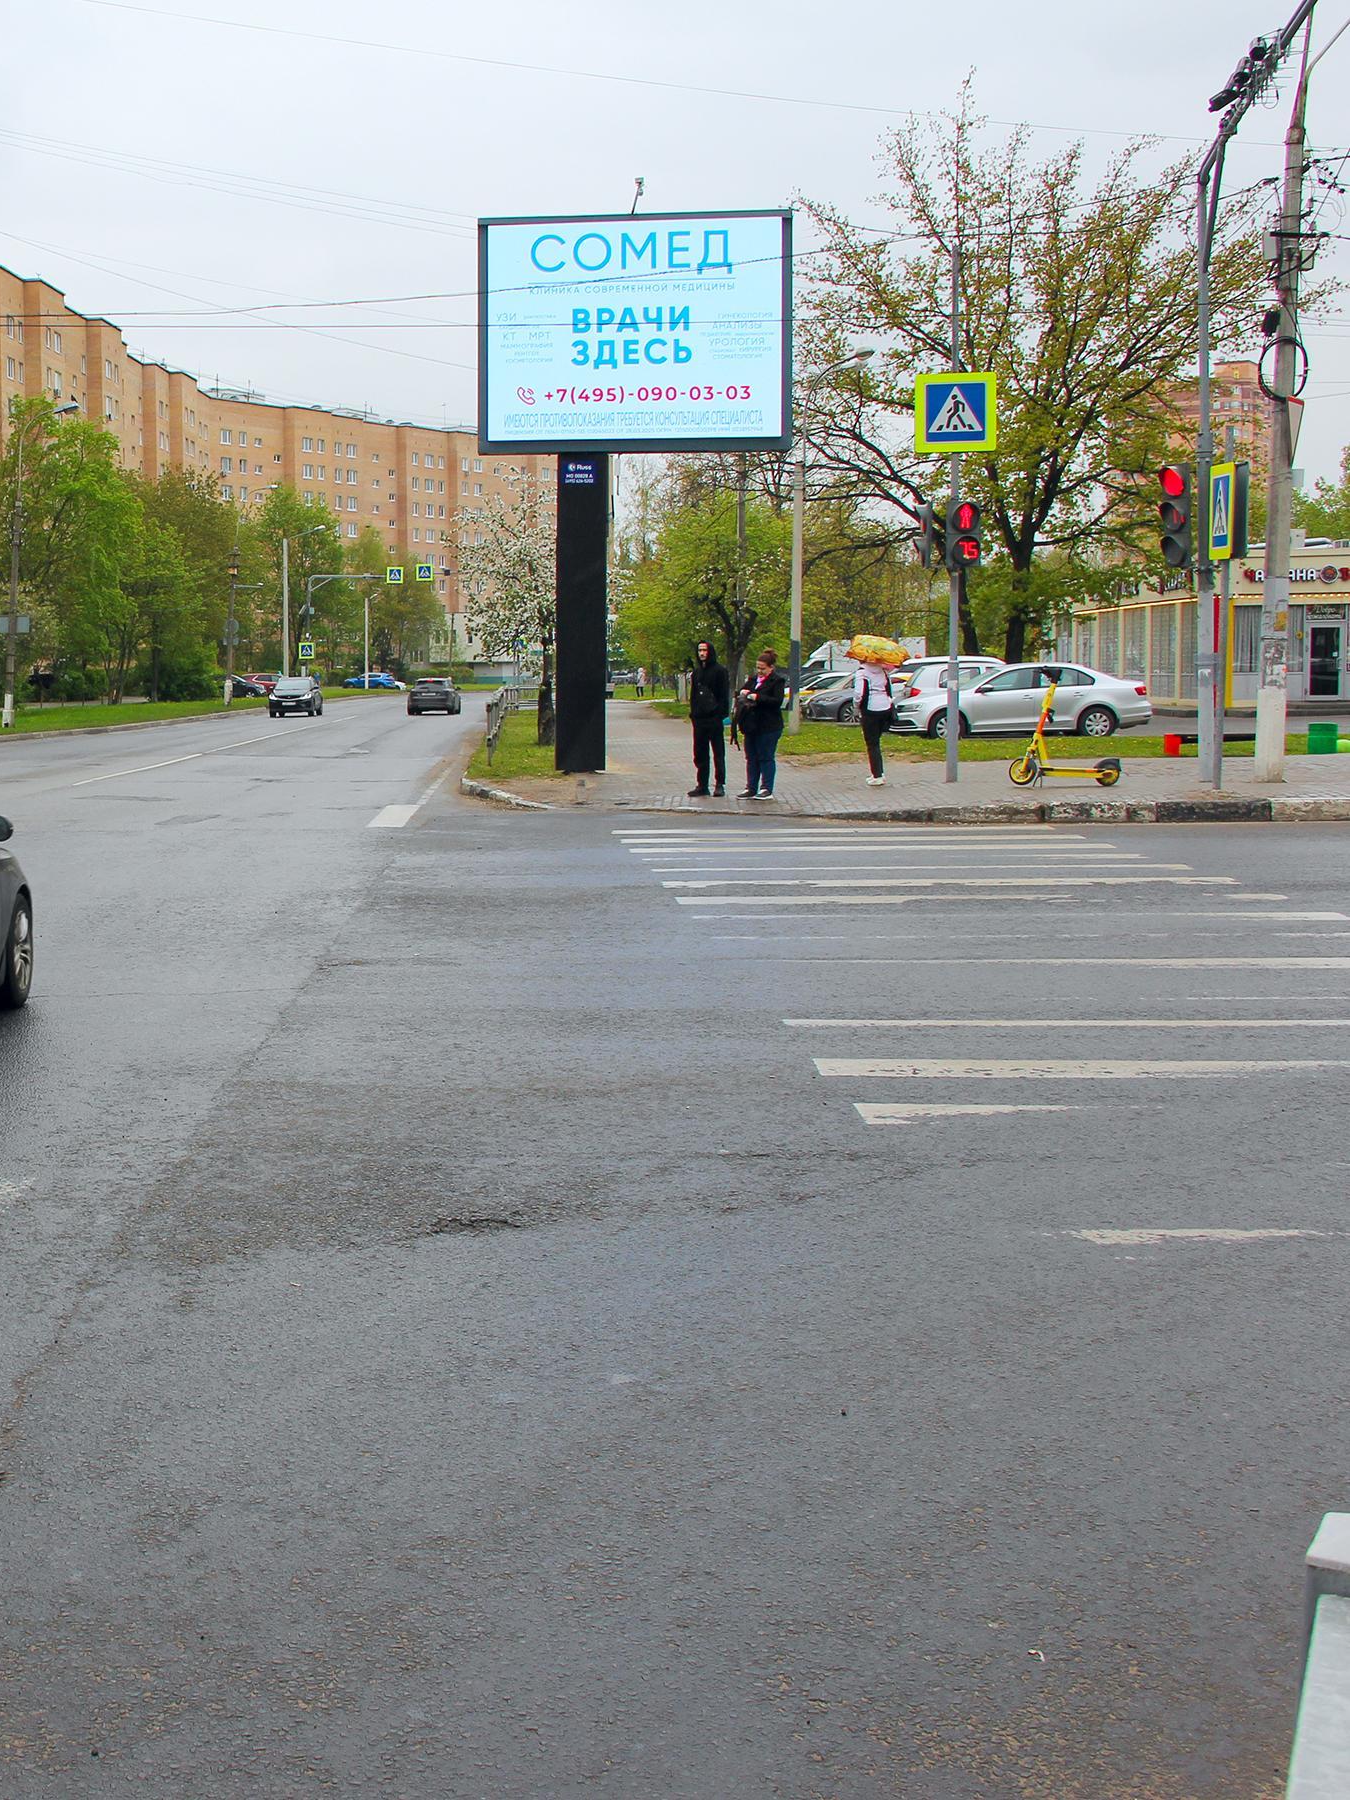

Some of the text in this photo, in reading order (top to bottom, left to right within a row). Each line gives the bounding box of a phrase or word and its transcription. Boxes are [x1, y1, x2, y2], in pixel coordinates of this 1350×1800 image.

[530, 229, 733, 274] СОМЕД
[529, 282, 735, 295] КЛИНИКА СОВРЕМЕННОЙ МЕДИЦИНЫ
[496, 312, 517, 322] УЗИ
[571, 305, 690, 334] ВРАЧИ
[502, 331, 551, 341] КТ МРТ
[708, 337, 765, 346] УРОЛОГИЯ
[571, 338, 693, 369] ЗДЕСЬ
[544, 385, 751, 405] +7(495)-090-03-03
